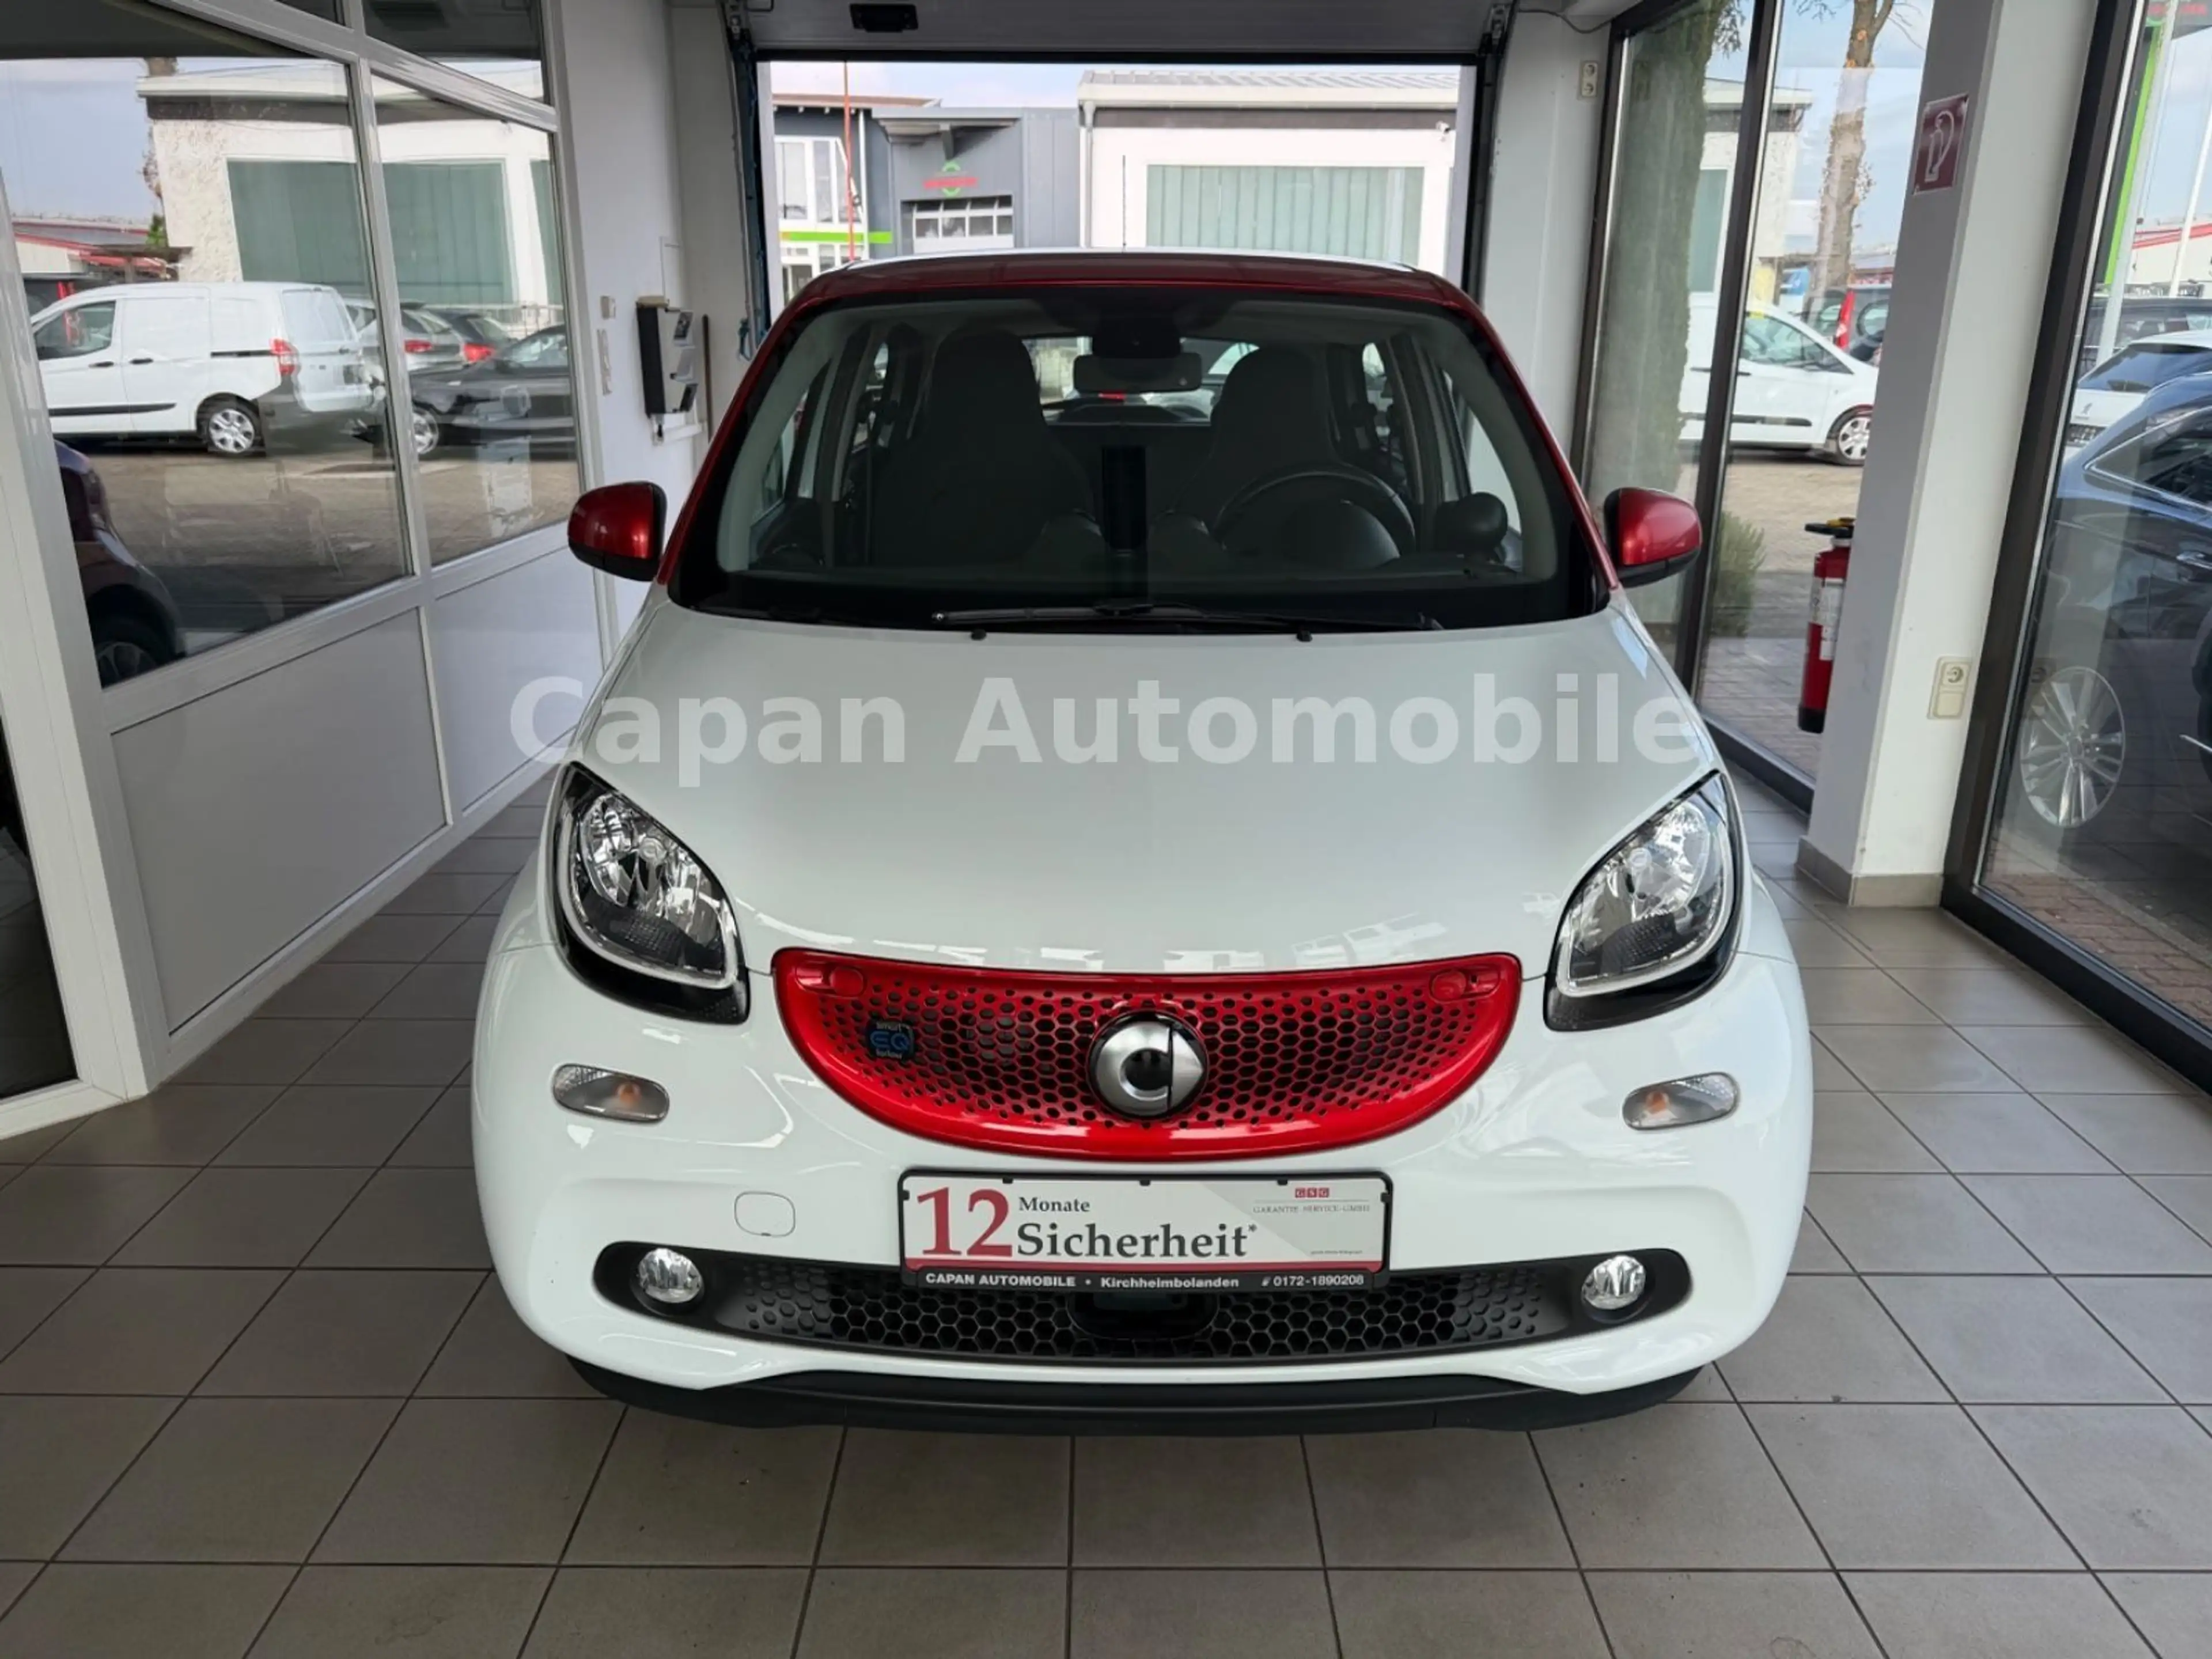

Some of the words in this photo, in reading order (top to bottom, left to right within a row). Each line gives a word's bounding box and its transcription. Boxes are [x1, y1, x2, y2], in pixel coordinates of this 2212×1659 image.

[1018, 1196, 1090, 1213] Monate
[917, 1187, 1013, 1257] 12
[925, 1272, 975, 1285] CAPAN
[979, 1275, 1076, 1287] AUTOMOBILE
[1101, 1277, 1239, 1289] Kirchheimbolanden
[1272, 1274, 1365, 1287] 0172-1890208
